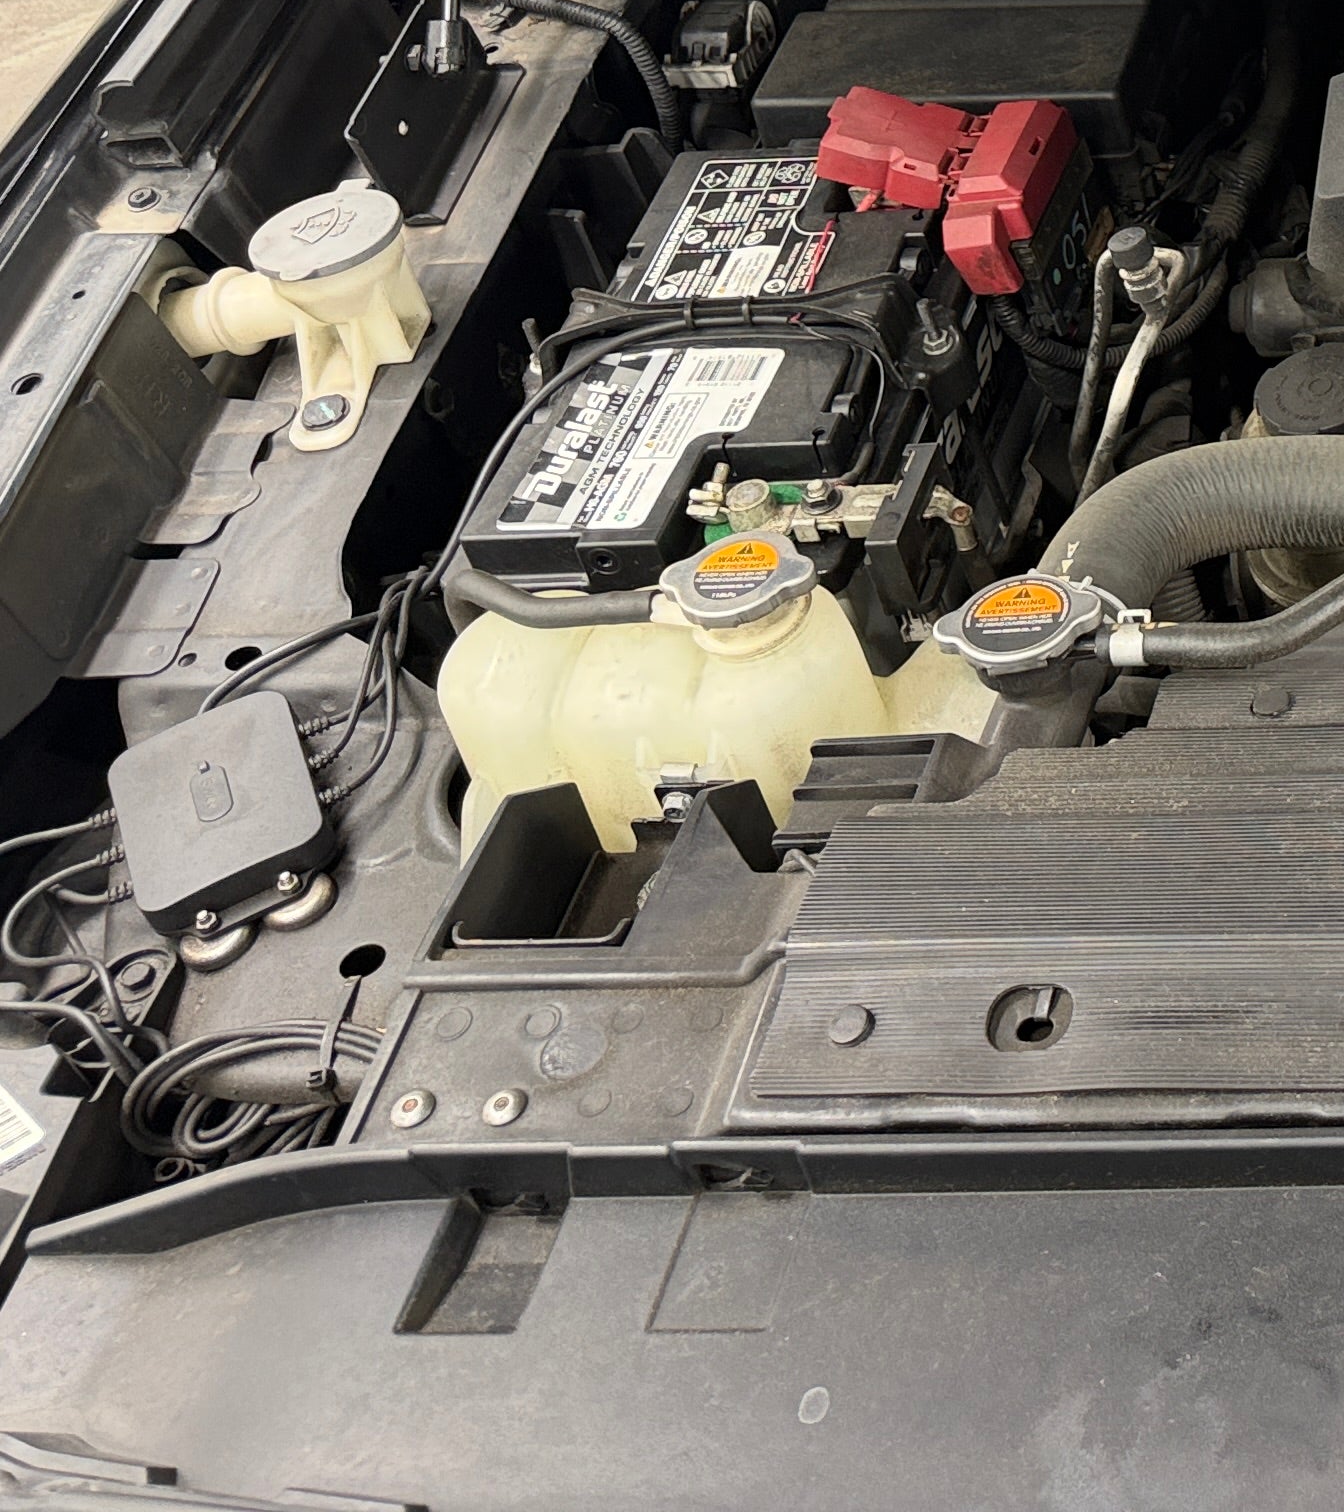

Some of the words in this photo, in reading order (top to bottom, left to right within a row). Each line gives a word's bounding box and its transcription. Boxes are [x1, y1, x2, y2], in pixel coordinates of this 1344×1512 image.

[521, 379, 619, 498] Duralast
[579, 467, 600, 496] AGM
[596, 388, 646, 463] TECHNOLOGY
[583, 384, 633, 454] PLATINUM
[995, 598, 1046, 607] WARNING
